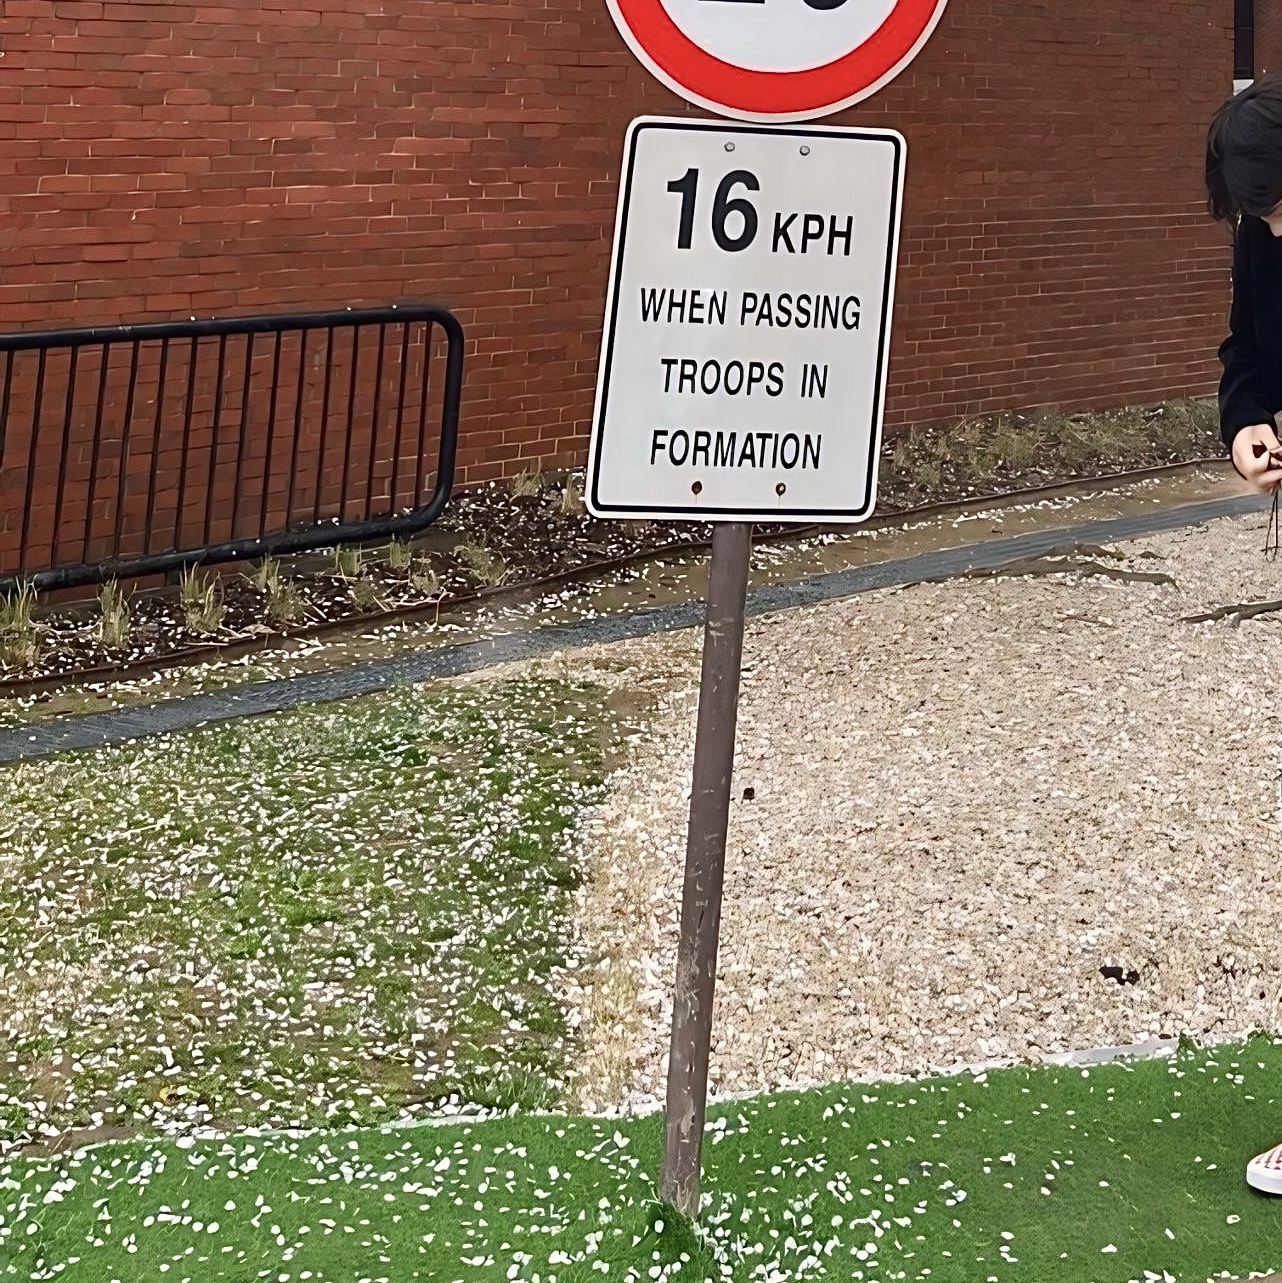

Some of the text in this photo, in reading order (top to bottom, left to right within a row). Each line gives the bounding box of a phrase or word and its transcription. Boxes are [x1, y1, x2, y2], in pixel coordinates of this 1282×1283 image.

[667, 168, 854, 256] 16 KPH
[640, 288, 861, 329] WHEN PASSING
[661, 358, 828, 398] TROOPS IN
[650, 430, 822, 469] FORMATION
